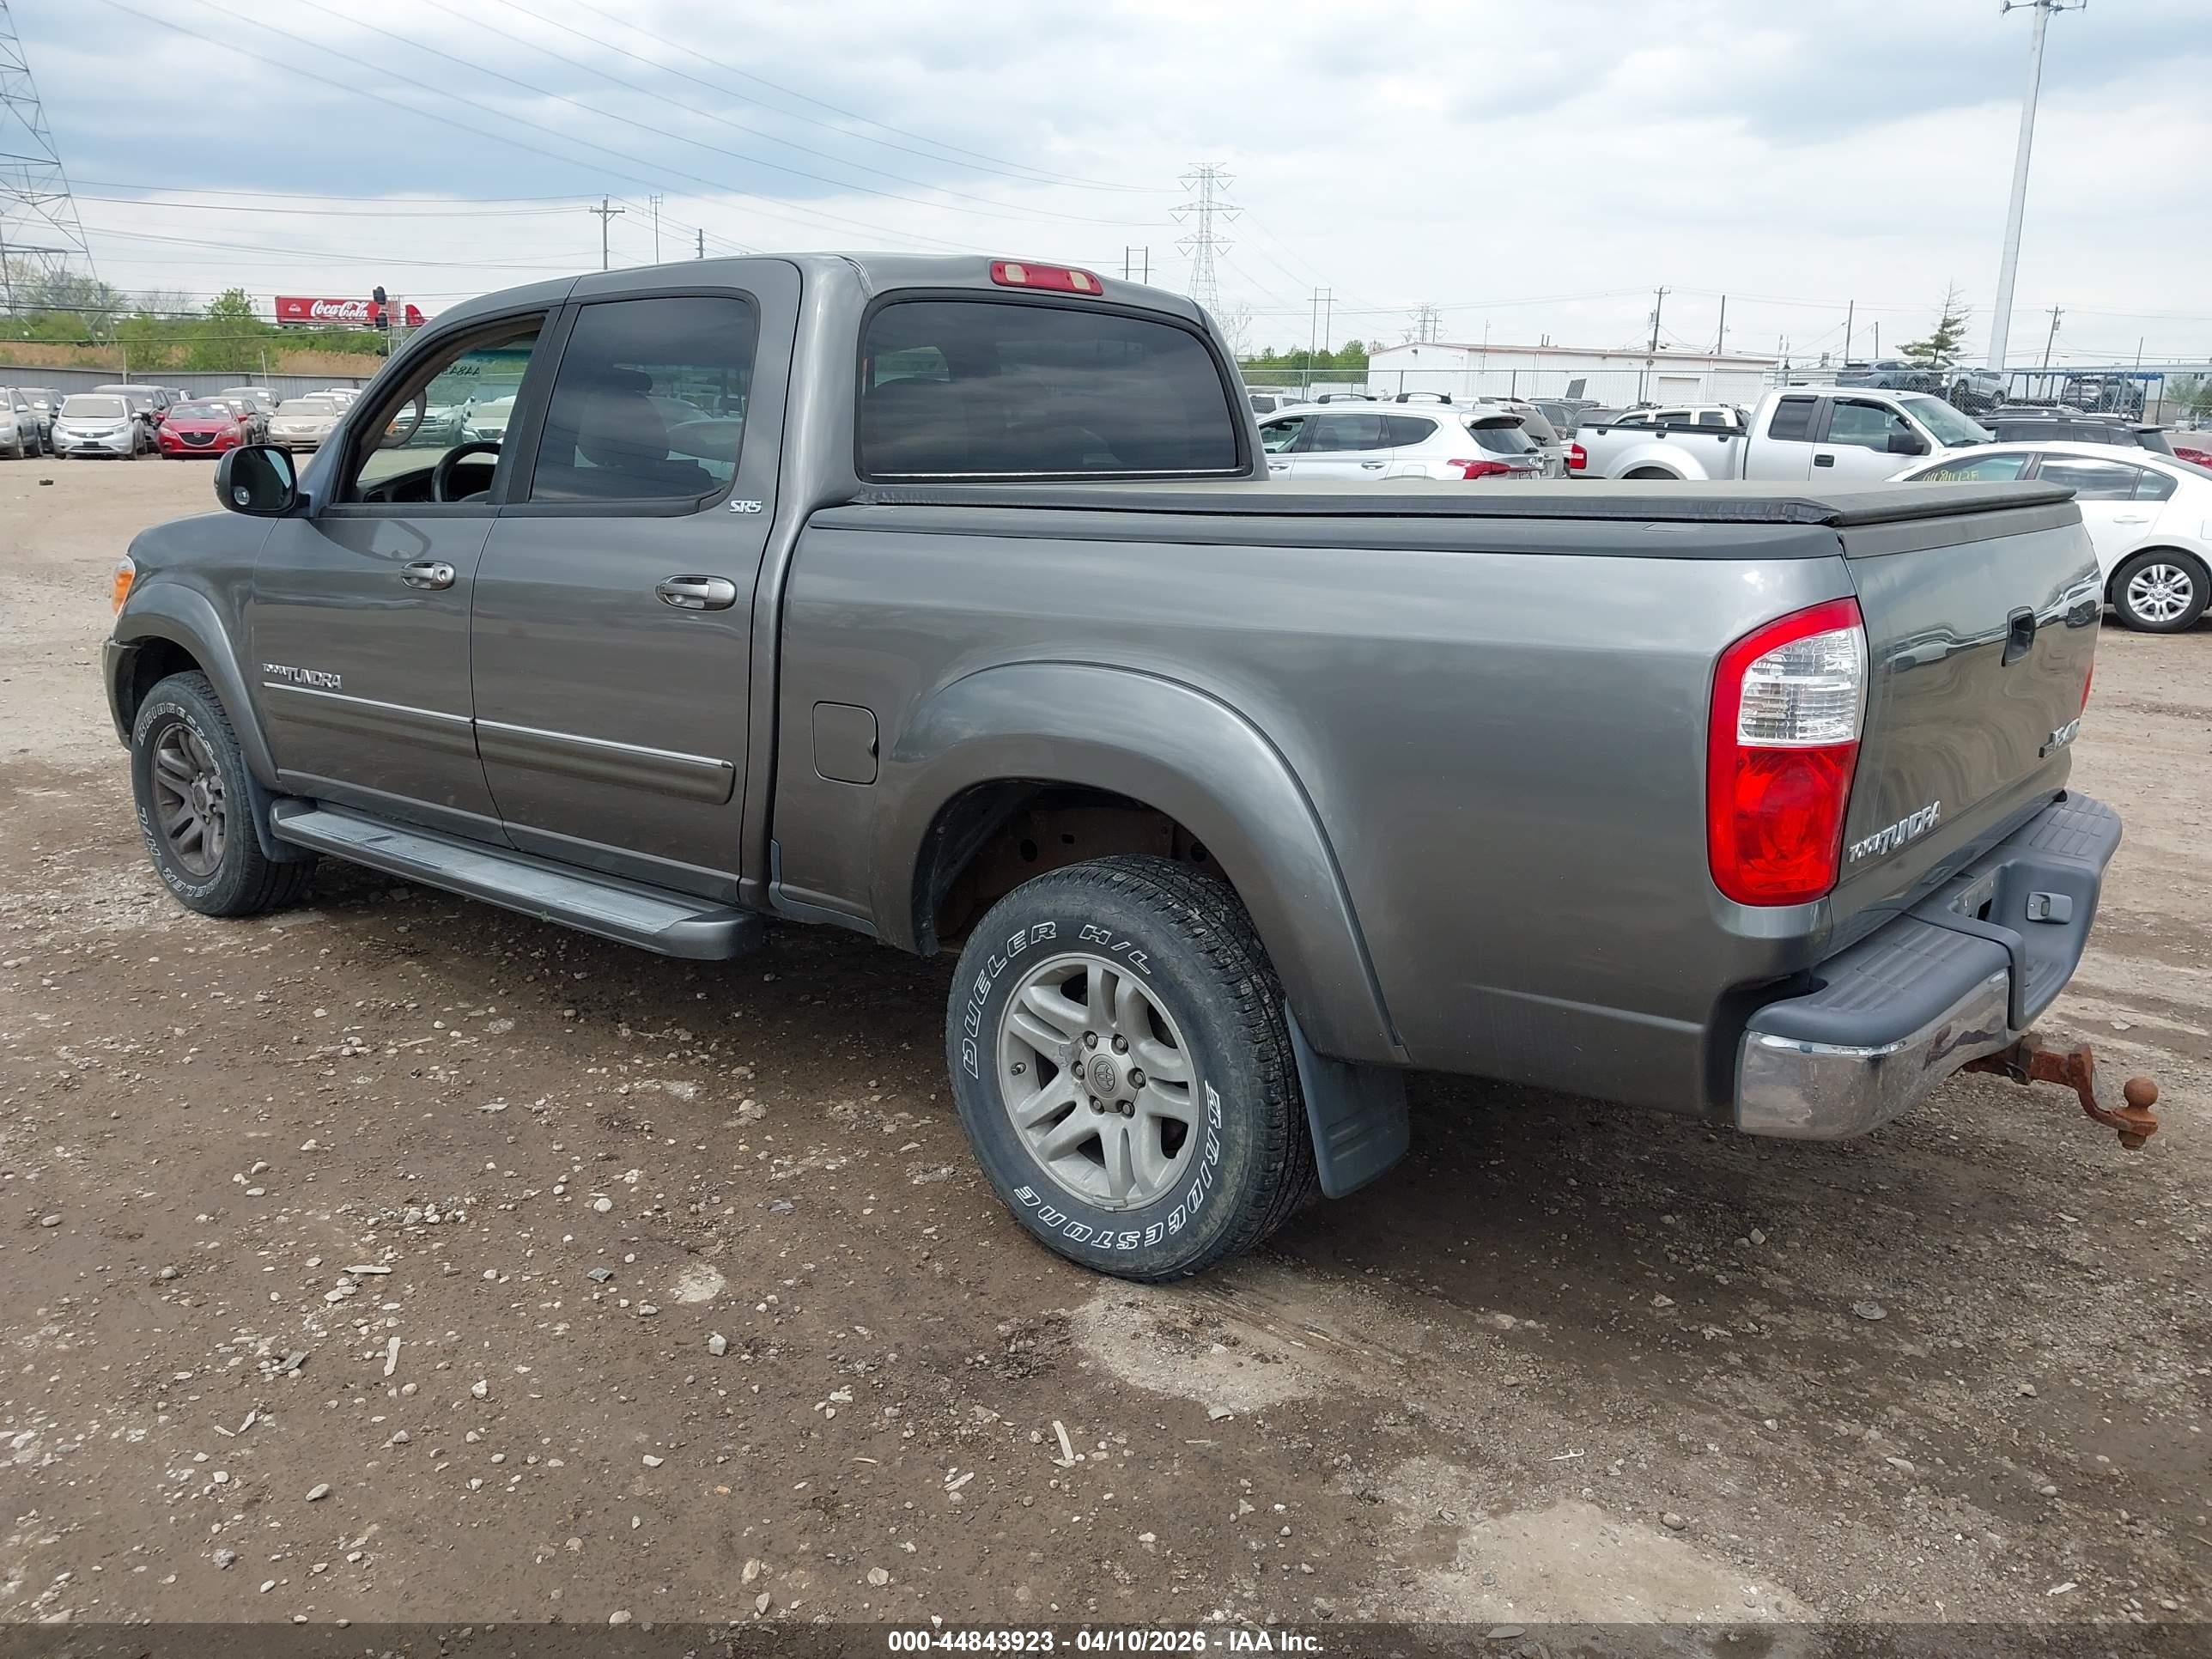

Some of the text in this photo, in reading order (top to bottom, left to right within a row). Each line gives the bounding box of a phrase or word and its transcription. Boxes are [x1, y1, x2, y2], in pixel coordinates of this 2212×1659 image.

[729, 500, 763, 513] SR5
[286, 666, 343, 690] TUNDRA
[137, 702, 228, 799] BRIDGESTONE
[963, 921, 1152, 1079] DUELER H/L
[1014, 1080, 1223, 1250] BRIDGESTONE
